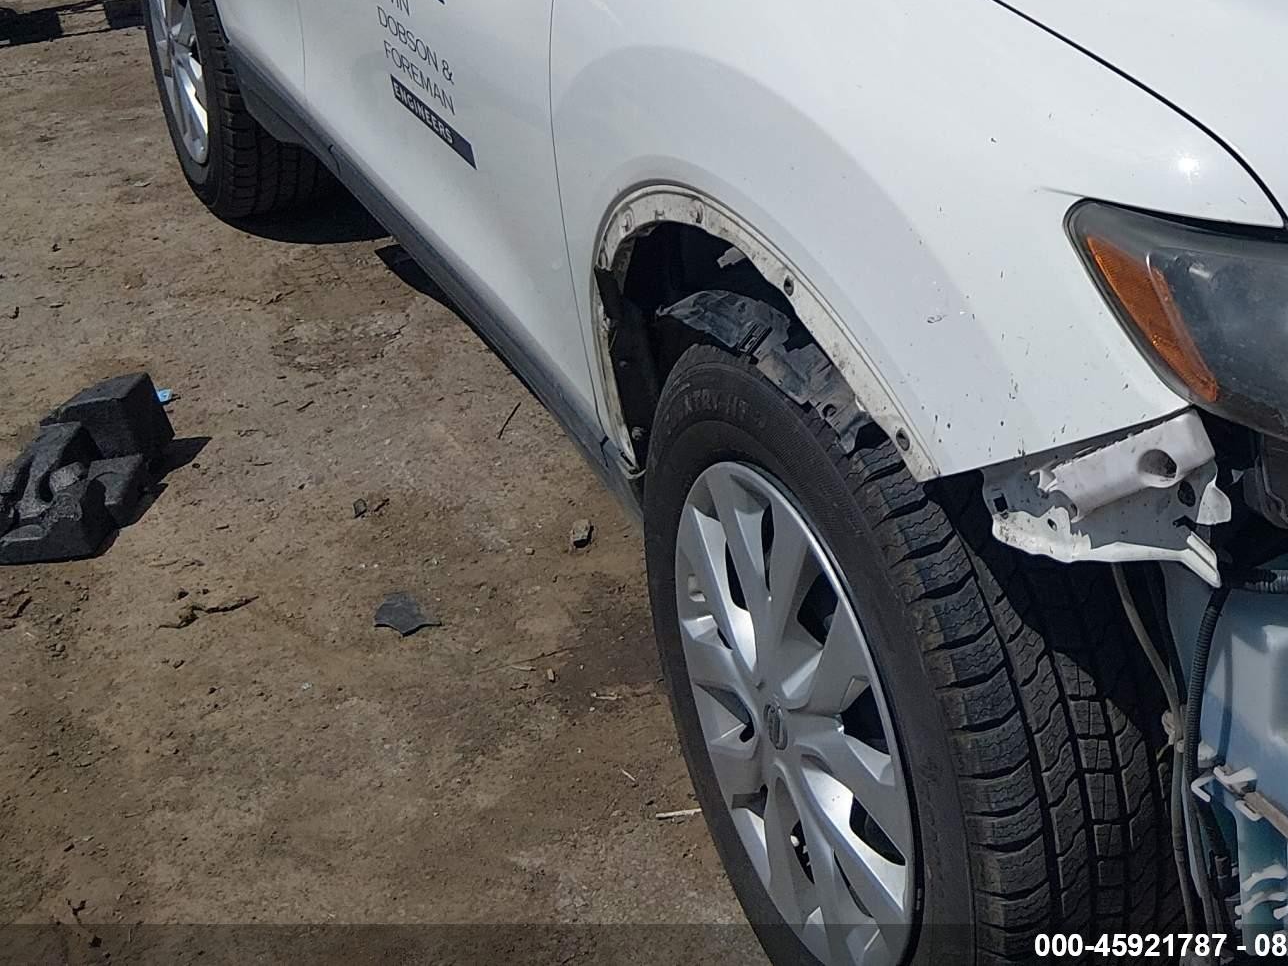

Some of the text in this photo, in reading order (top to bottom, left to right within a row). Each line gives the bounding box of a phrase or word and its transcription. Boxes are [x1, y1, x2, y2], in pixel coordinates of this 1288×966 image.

[376, 5, 456, 85] DOBSON &
[384, 39, 457, 116] FOREMAN
[393, 81, 454, 145] ENGINEERS
